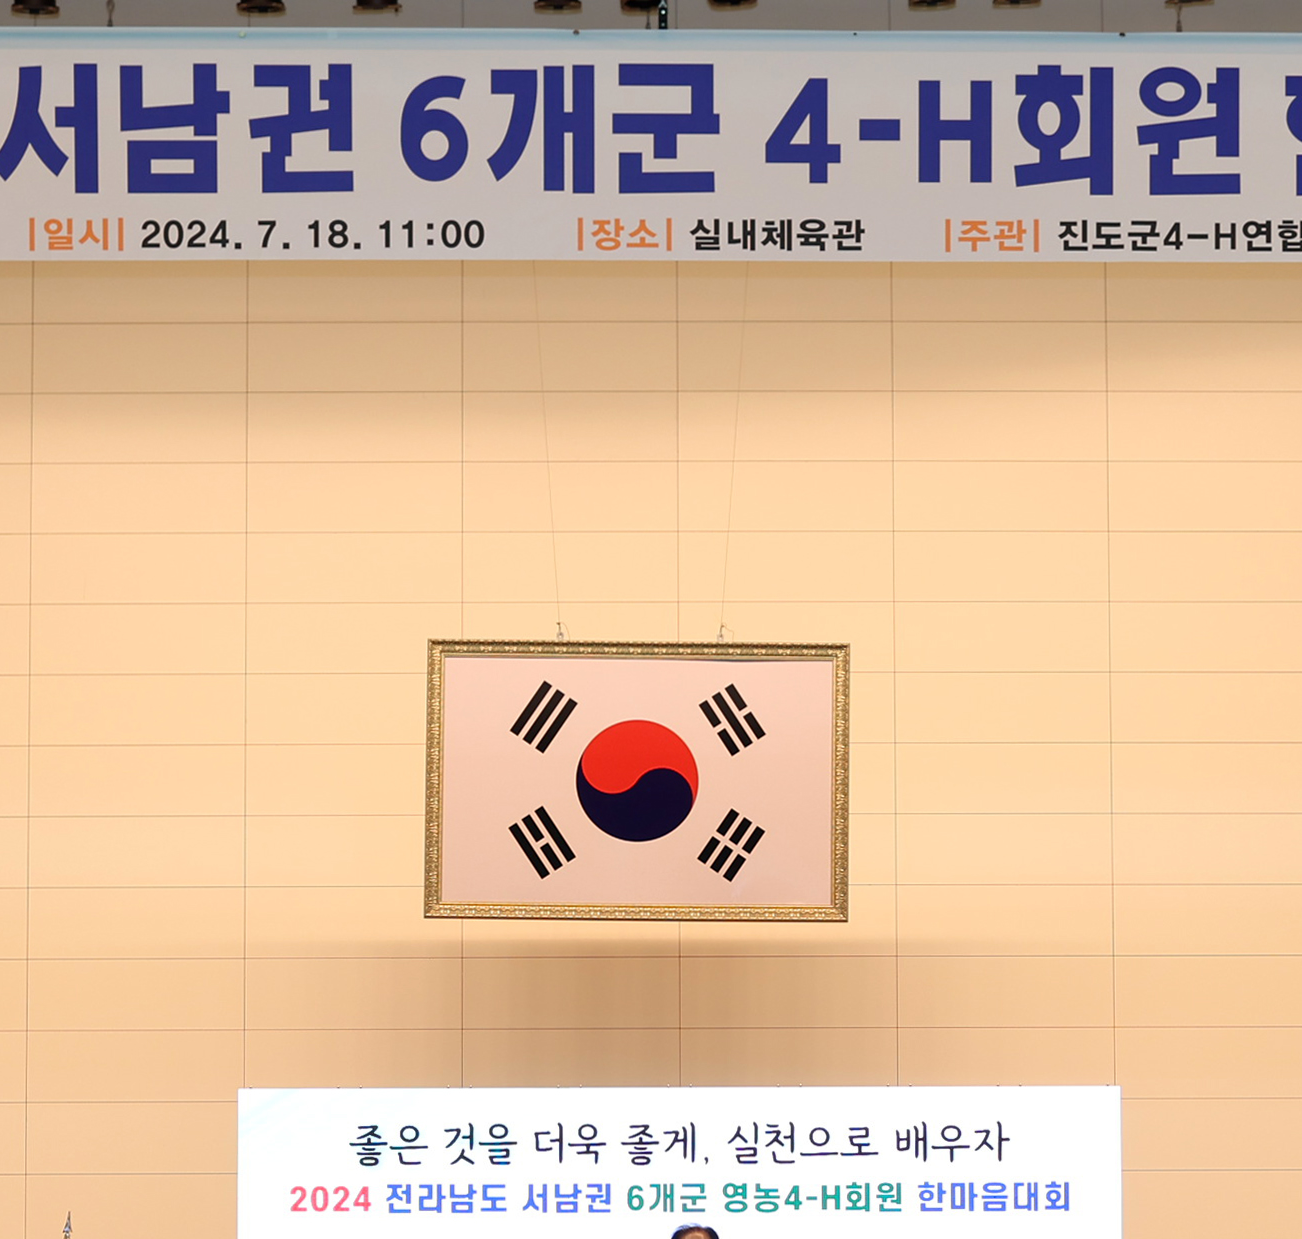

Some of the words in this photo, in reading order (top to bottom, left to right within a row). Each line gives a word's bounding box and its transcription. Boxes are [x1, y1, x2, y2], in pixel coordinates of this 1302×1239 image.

[400, 62, 720, 195] 6개군
[764, 64, 1242, 196] 4-H회원
[141, 219, 242, 250] 2024.
[257, 220, 290, 250] 7.
[307, 219, 362, 250] 18.
[378, 219, 485, 249] 11:00
[689, 218, 866, 252] 실내체육관
[348, 1124, 429, 1167] 좋은
[443, 1122, 518, 1166] 것을
[533, 1122, 607, 1165] 더욱
[620, 1121, 710, 1166] 좋게,
[727, 1121, 879, 1165] 실천으로
[895, 1120, 1011, 1163] 배우자
[290, 1185, 372, 1213] 2024
[385, 1183, 508, 1214] 전라남도
[522, 1183, 611, 1214] 서남권
[626, 1183, 707, 1213] 6개군
[722, 1181, 902, 1214] 영농4-H회원
[917, 1180, 1070, 1212] 한마음대회
